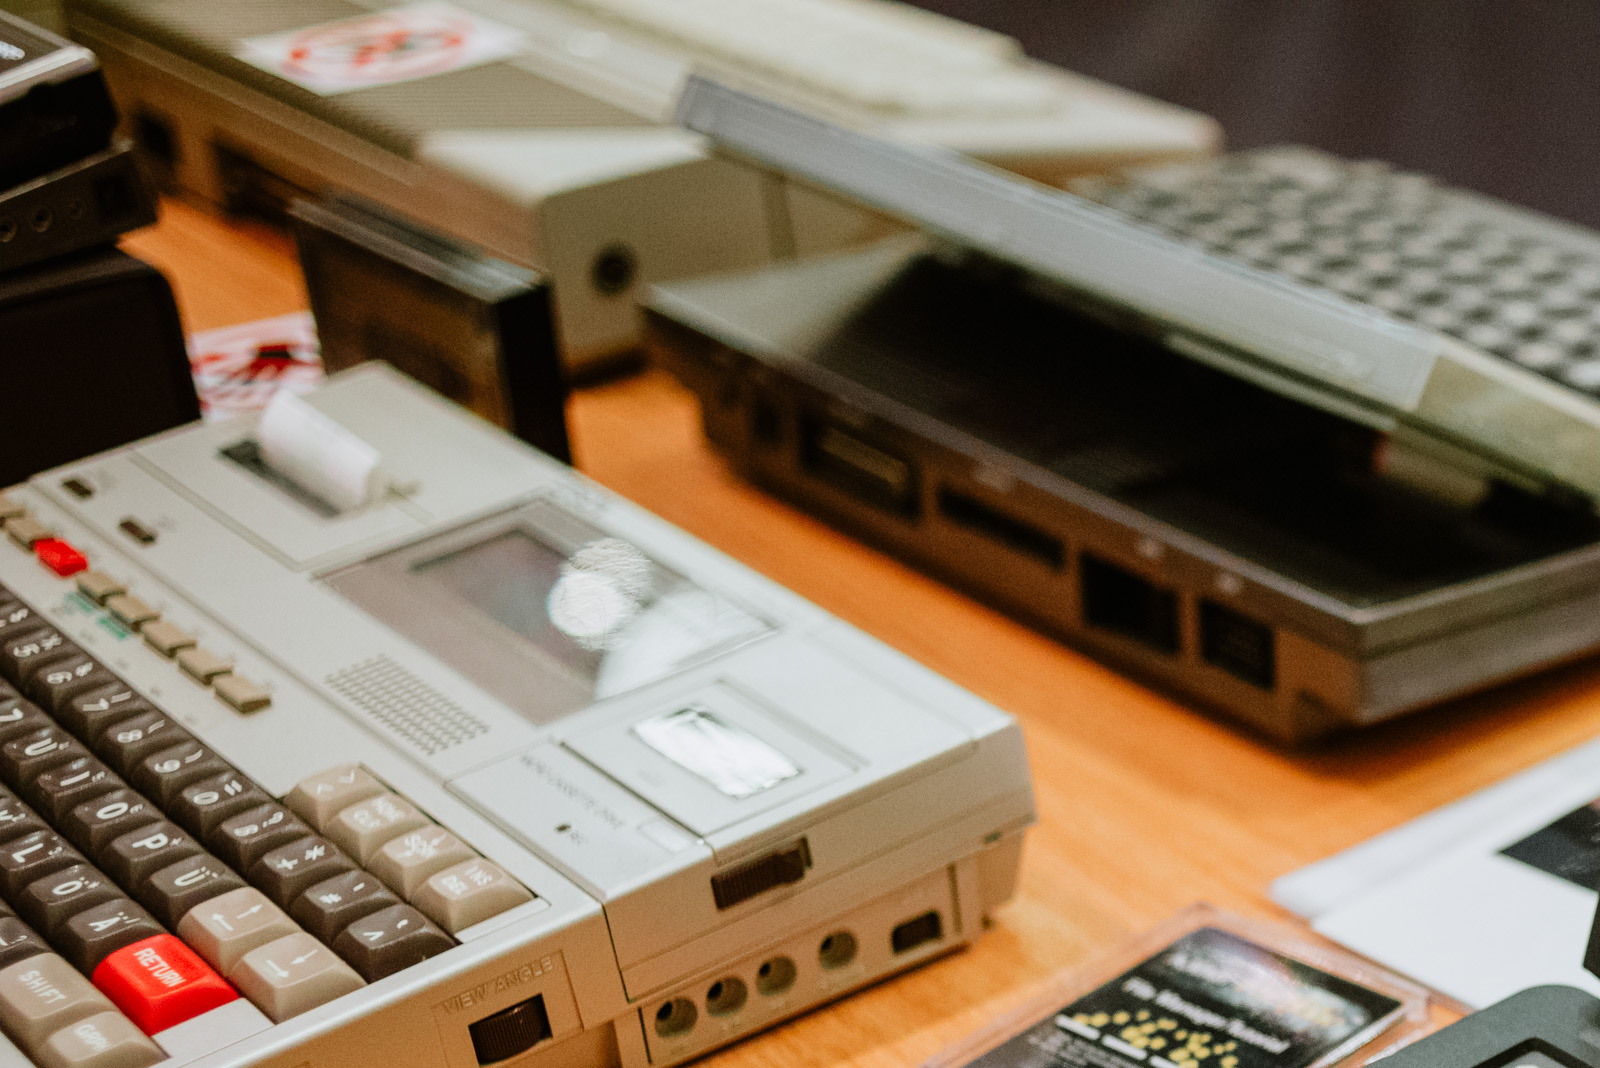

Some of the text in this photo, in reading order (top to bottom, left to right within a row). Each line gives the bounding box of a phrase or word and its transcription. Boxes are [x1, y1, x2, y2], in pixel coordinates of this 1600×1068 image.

[117, 729, 143, 743] 8
[24, 737, 58, 756] U
[154, 759, 181, 773] 9
[132, 832, 169, 850] P
[11, 842, 44, 863] L
[133, 947, 187, 988] RETURN
[18, 970, 67, 1005] SHIFT
[443, 955, 553, 1013] VIEW ANGLE
